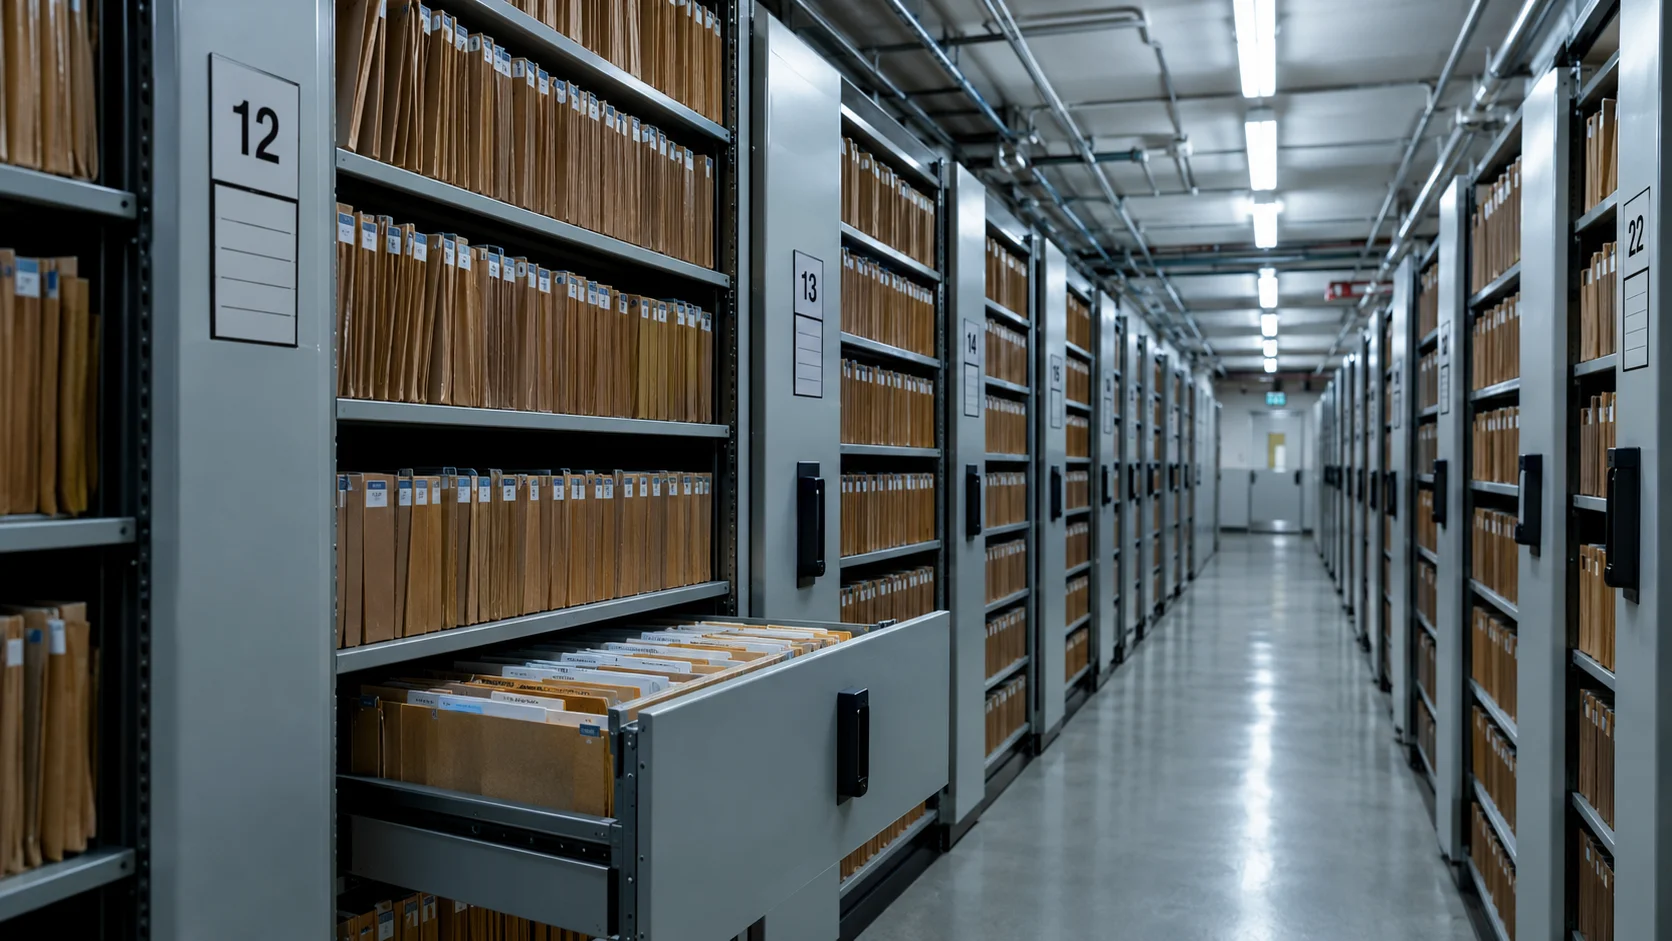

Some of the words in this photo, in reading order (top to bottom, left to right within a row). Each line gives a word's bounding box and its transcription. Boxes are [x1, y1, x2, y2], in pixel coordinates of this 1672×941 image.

[233, 100, 280, 164] 12
[1628, 214, 1644, 258] 22
[801, 271, 817, 302] 13
[967, 332, 977, 354] 14
